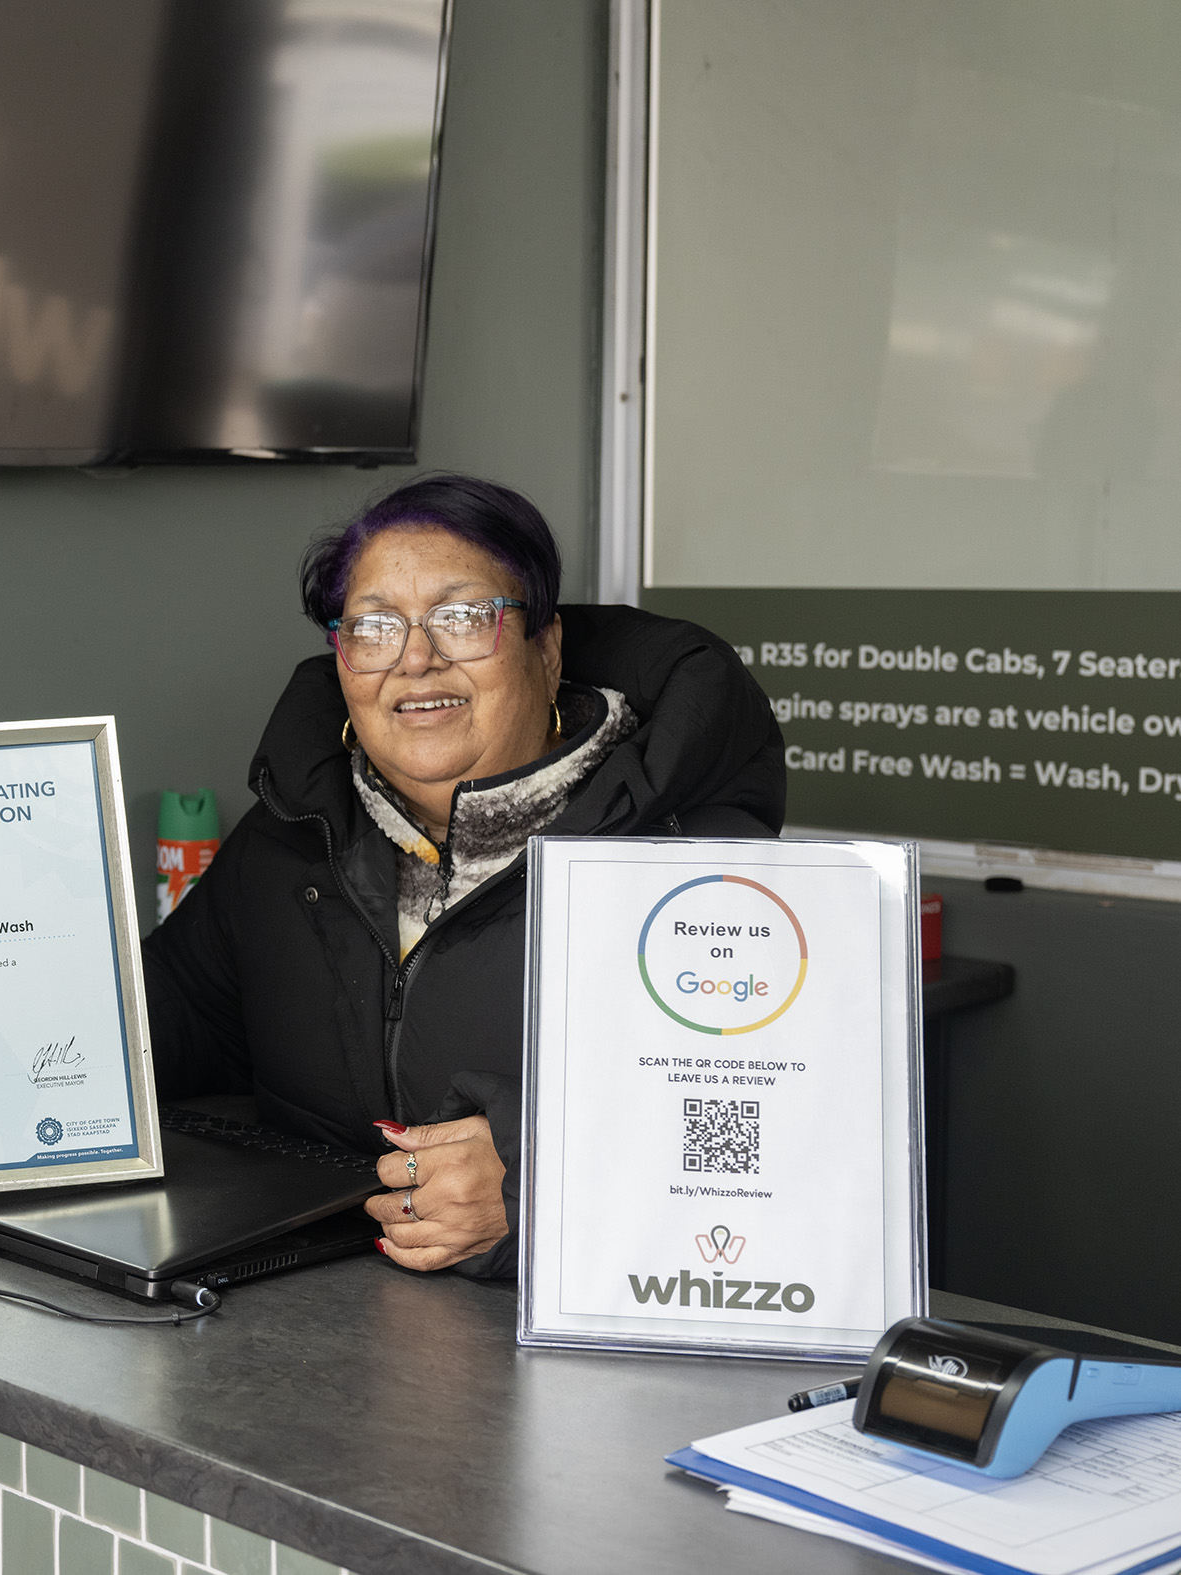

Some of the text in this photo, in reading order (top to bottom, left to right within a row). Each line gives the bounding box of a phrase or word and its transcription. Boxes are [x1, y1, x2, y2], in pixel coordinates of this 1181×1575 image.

[760, 642, 807, 667] R35
[813, 642, 852, 669] for
[858, 644, 958, 672] Double
[965, 647, 1045, 680] Cabs,
[1052, 650, 1072, 676] 7
[1078, 650, 1181, 680] Seater
[839, 699, 928, 729] sprays
[934, 705, 982, 727] are
[988, 705, 1018, 729] at
[1025, 705, 1136, 735] vehicle
[785, 745, 846, 773] Card
[852, 749, 913, 777] Free
[919, 754, 1001, 783] Wash
[1009, 763, 1027, 780] =
[1034, 760, 1130, 796] Wash,
[674, 921, 771, 938] Review us
[710, 947, 733, 959] on
[11, 959, 17, 967] a
[676, 971, 769, 1002] Google
[639, 1057, 806, 1072] SCAN THE QR CODE BELOW TO
[59, 1073, 87, 1081] HILL-LEWIS
[668, 1073, 776, 1086] LEAVE US A REVIEW
[37, 1153, 56, 1161] Making
[56, 1151, 77, 1159] progress
[670, 1184, 773, 1199] bit.ly/WhizzoReview
[627, 1269, 815, 1314] whizzo
